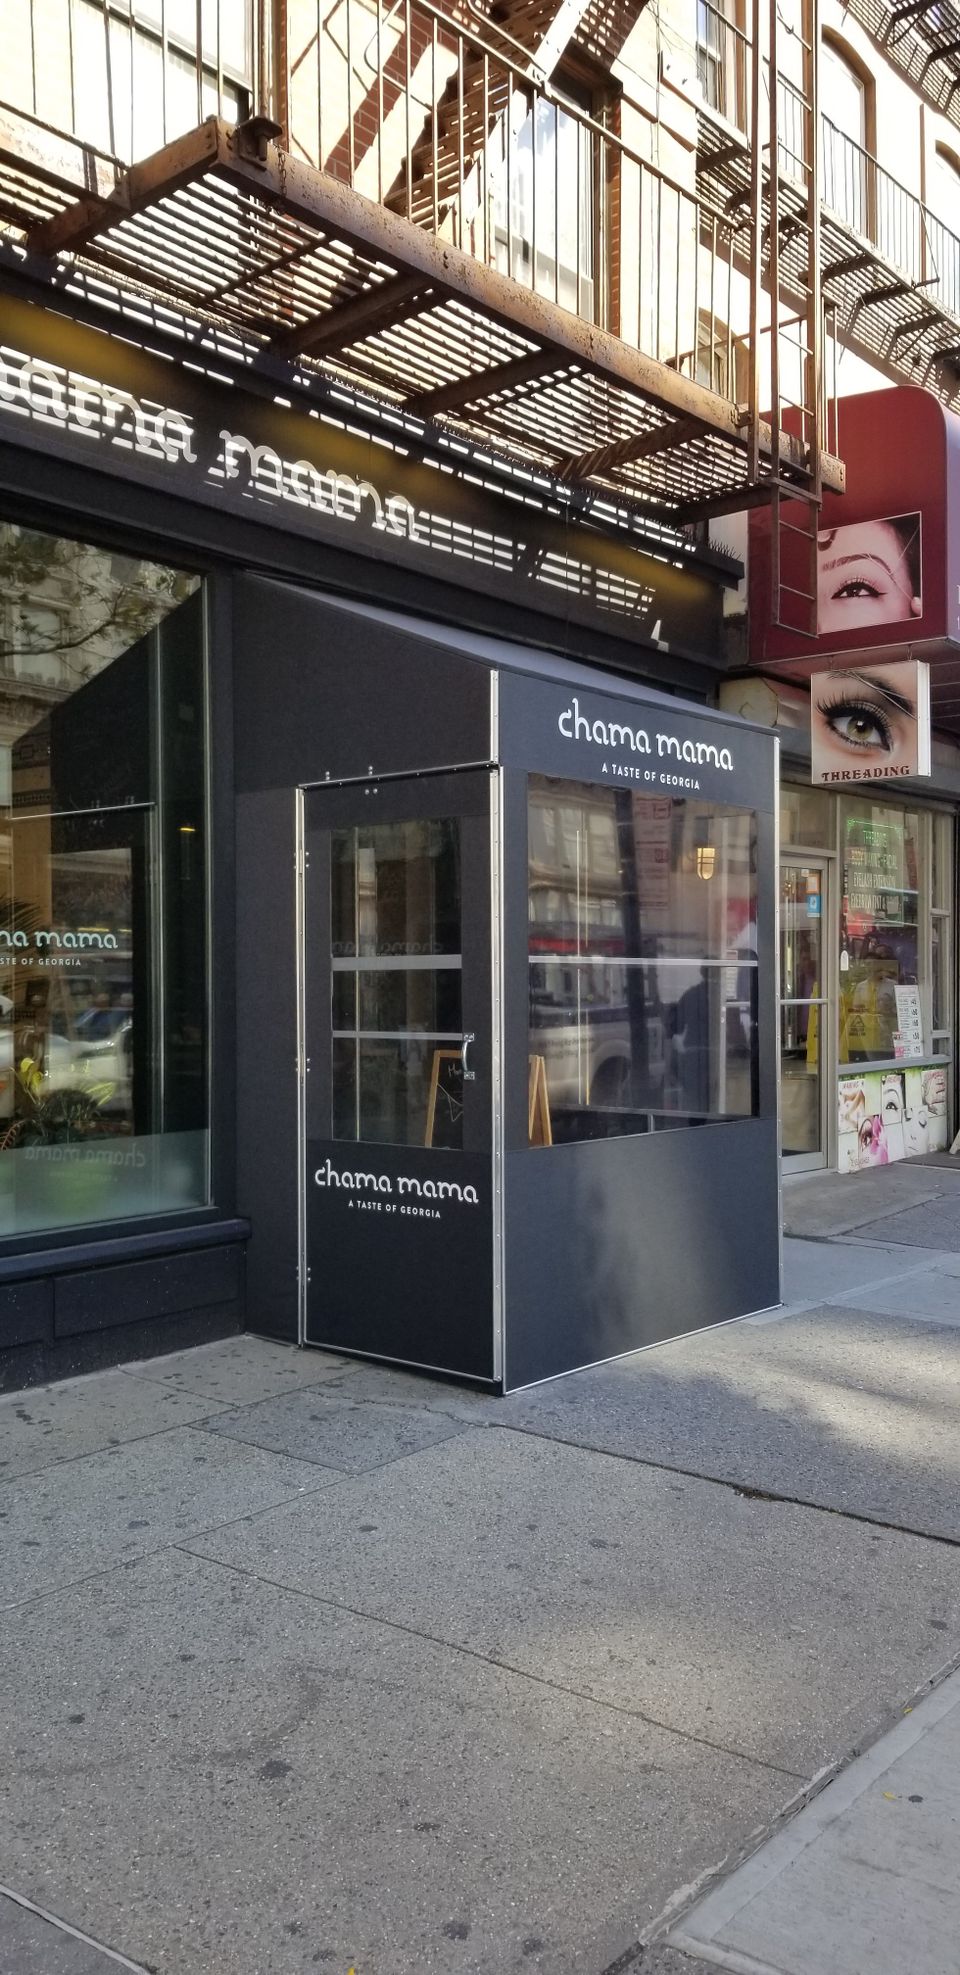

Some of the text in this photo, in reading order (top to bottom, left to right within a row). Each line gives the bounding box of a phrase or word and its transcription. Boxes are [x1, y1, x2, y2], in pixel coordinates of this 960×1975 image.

[219, 430, 420, 541] mama
[558, 697, 734, 771] chama mama
[601, 762, 700, 790] A TASTE OF GEORGIA
[821, 765, 910, 782] THREADING
[34, 931, 118, 949] mama
[21, 957, 34, 965] OF
[38, 958, 81, 966] GEORGIA
[314, 1158, 479, 1204] chama mama
[348, 1199, 441, 1219] A TASTE OF GEORGIA
